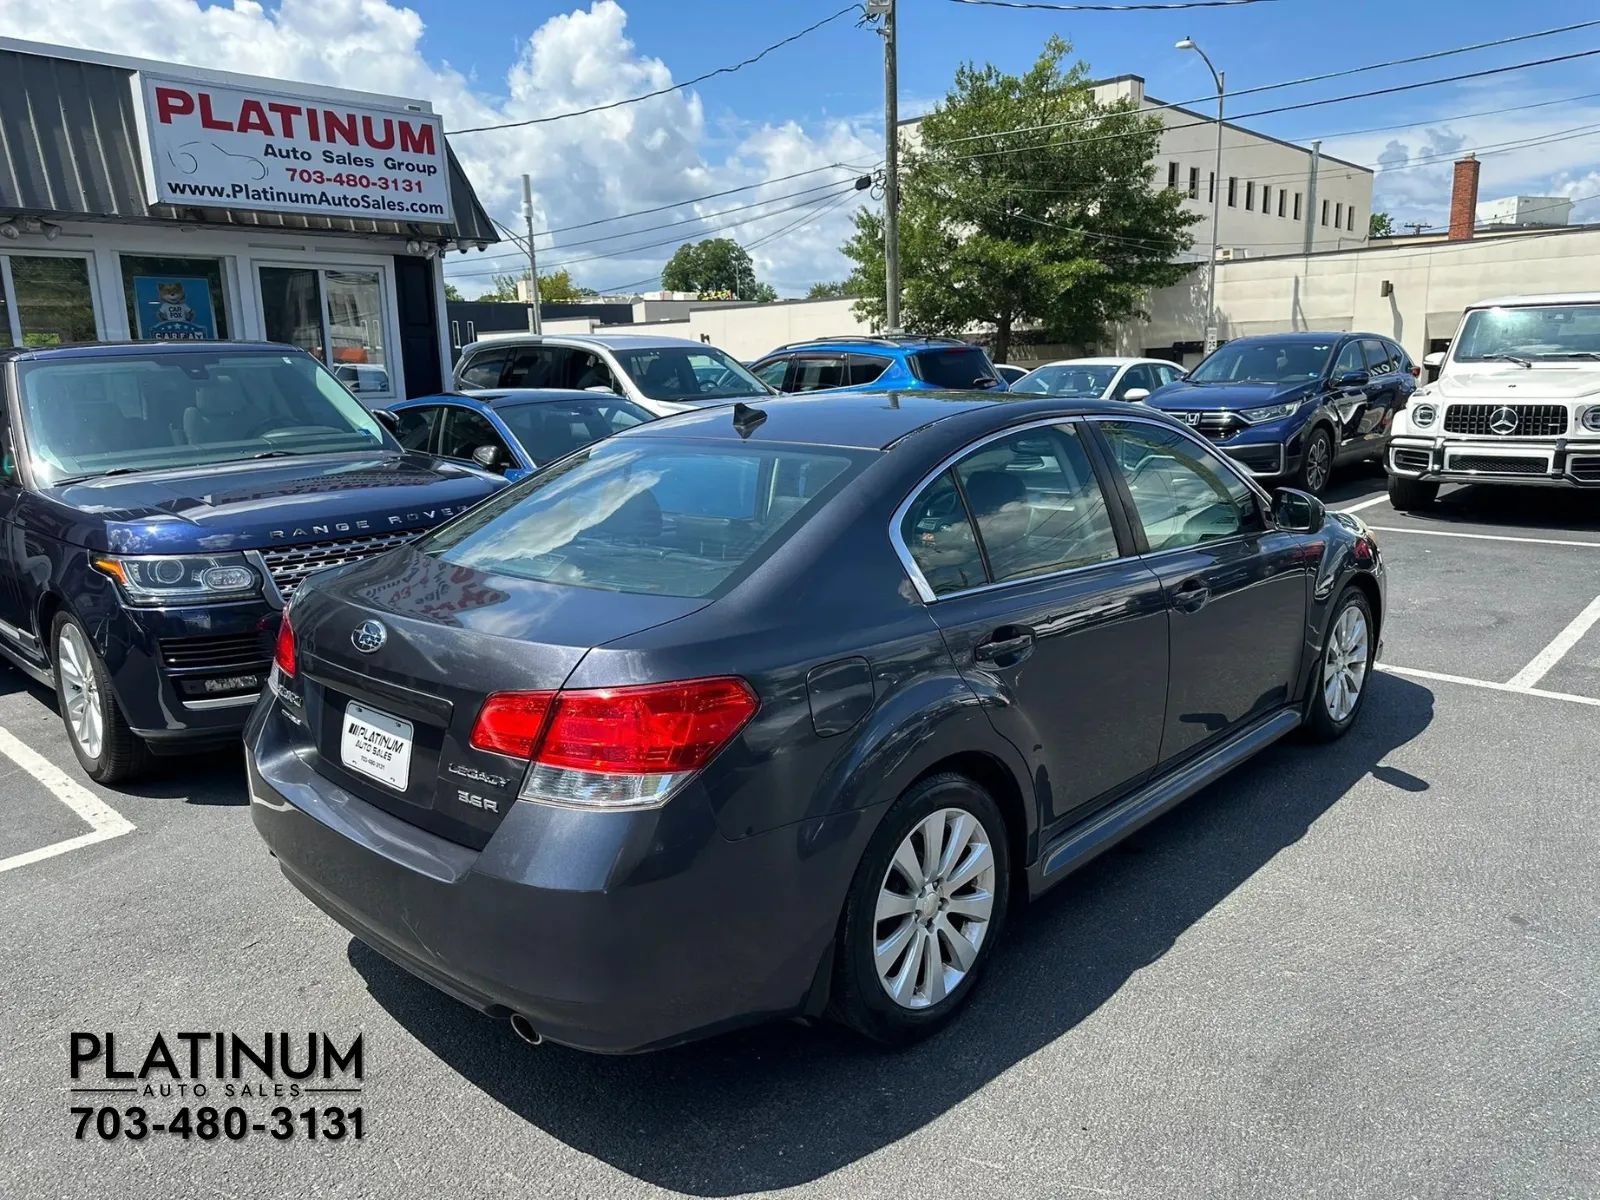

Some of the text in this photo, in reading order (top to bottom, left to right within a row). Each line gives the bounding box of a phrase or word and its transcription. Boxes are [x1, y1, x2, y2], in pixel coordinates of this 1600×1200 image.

[155, 87, 436, 155] PLATINUM
[263, 143, 438, 177] Auto Sales Group
[285, 168, 423, 193] 703-480-3131
[168, 182, 444, 215] www.PlatinumAutoSales.com
[269, 520, 370, 540] RANGE
[355, 740, 393, 762] AUTO SALES
[357, 726, 404, 754] PLATINUM
[448, 763, 511, 787] LEGACY
